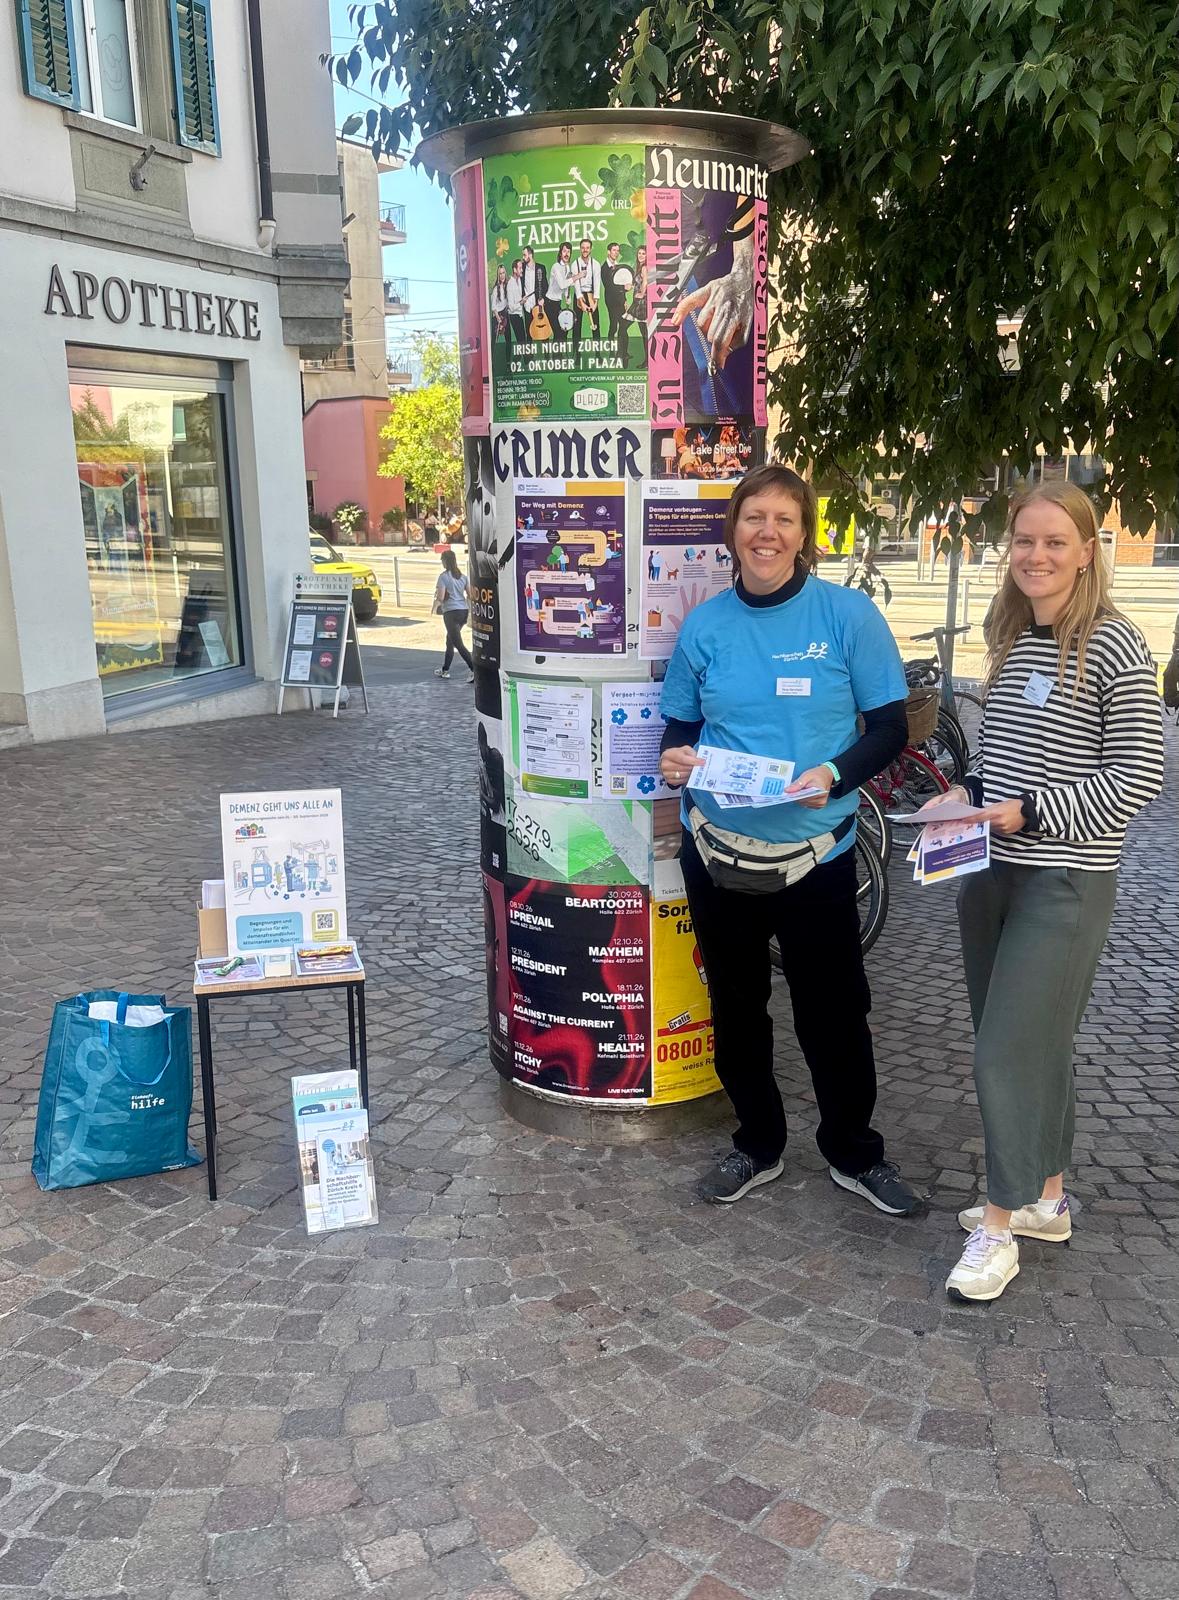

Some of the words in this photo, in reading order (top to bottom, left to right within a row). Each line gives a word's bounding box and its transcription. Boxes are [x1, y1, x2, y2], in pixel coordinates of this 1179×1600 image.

[647, 148, 769, 200] Neumarkt
[518, 192, 539, 208] THE
[542, 190, 578, 213] LED
[610, 199, 633, 210] (IRL)
[518, 220, 609, 246] FARMERS
[44, 263, 261, 341] APOTHEKE
[513, 343, 537, 356] IRISH
[541, 341, 573, 353] NIGHT
[578, 339, 618, 352] ZÜRICH
[510, 361, 525, 373] 02.
[528, 359, 575, 371] OKTOBER
[588, 357, 624, 369] PLAZA
[576, 393, 606, 406] PLAZA
[493, 427, 644, 483] CRIMER
[690, 444, 712, 455] Lake
[714, 444, 737, 455] Street
[738, 443, 752, 454] Dive
[532, 502, 545, 510] Weg
[480, 588, 493, 604] OF
[229, 803, 260, 814] DEMENZ
[262, 802, 282, 812] GEHT
[284, 801, 300, 811] UNS
[303, 800, 320, 810] ALLE
[322, 799, 333, 809] AN
[508, 819, 540, 861] 2026
[565, 897, 643, 909] BEARTOOTH
[607, 891, 643, 899] 30.09.26
[514, 910, 554, 928] PREVAIL
[676, 919, 692, 934] fü
[588, 946, 643, 957] MAYHEM
[511, 954, 567, 976] PRESIDENT
[582, 992, 644, 1003] POLYPHIA
[513, 1004, 547, 1020] AGAINST
[547, 1013, 566, 1024] THE
[567, 1016, 614, 1028] CURRENT
[668, 1013, 691, 1029] Gratis
[598, 1042, 645, 1052] HEALTH
[657, 1037, 702, 1063] 0800
[514, 1051, 542, 1068] ITCHY
[682, 1061, 704, 1071] weiss
[131, 1097, 165, 1109] hilfe
